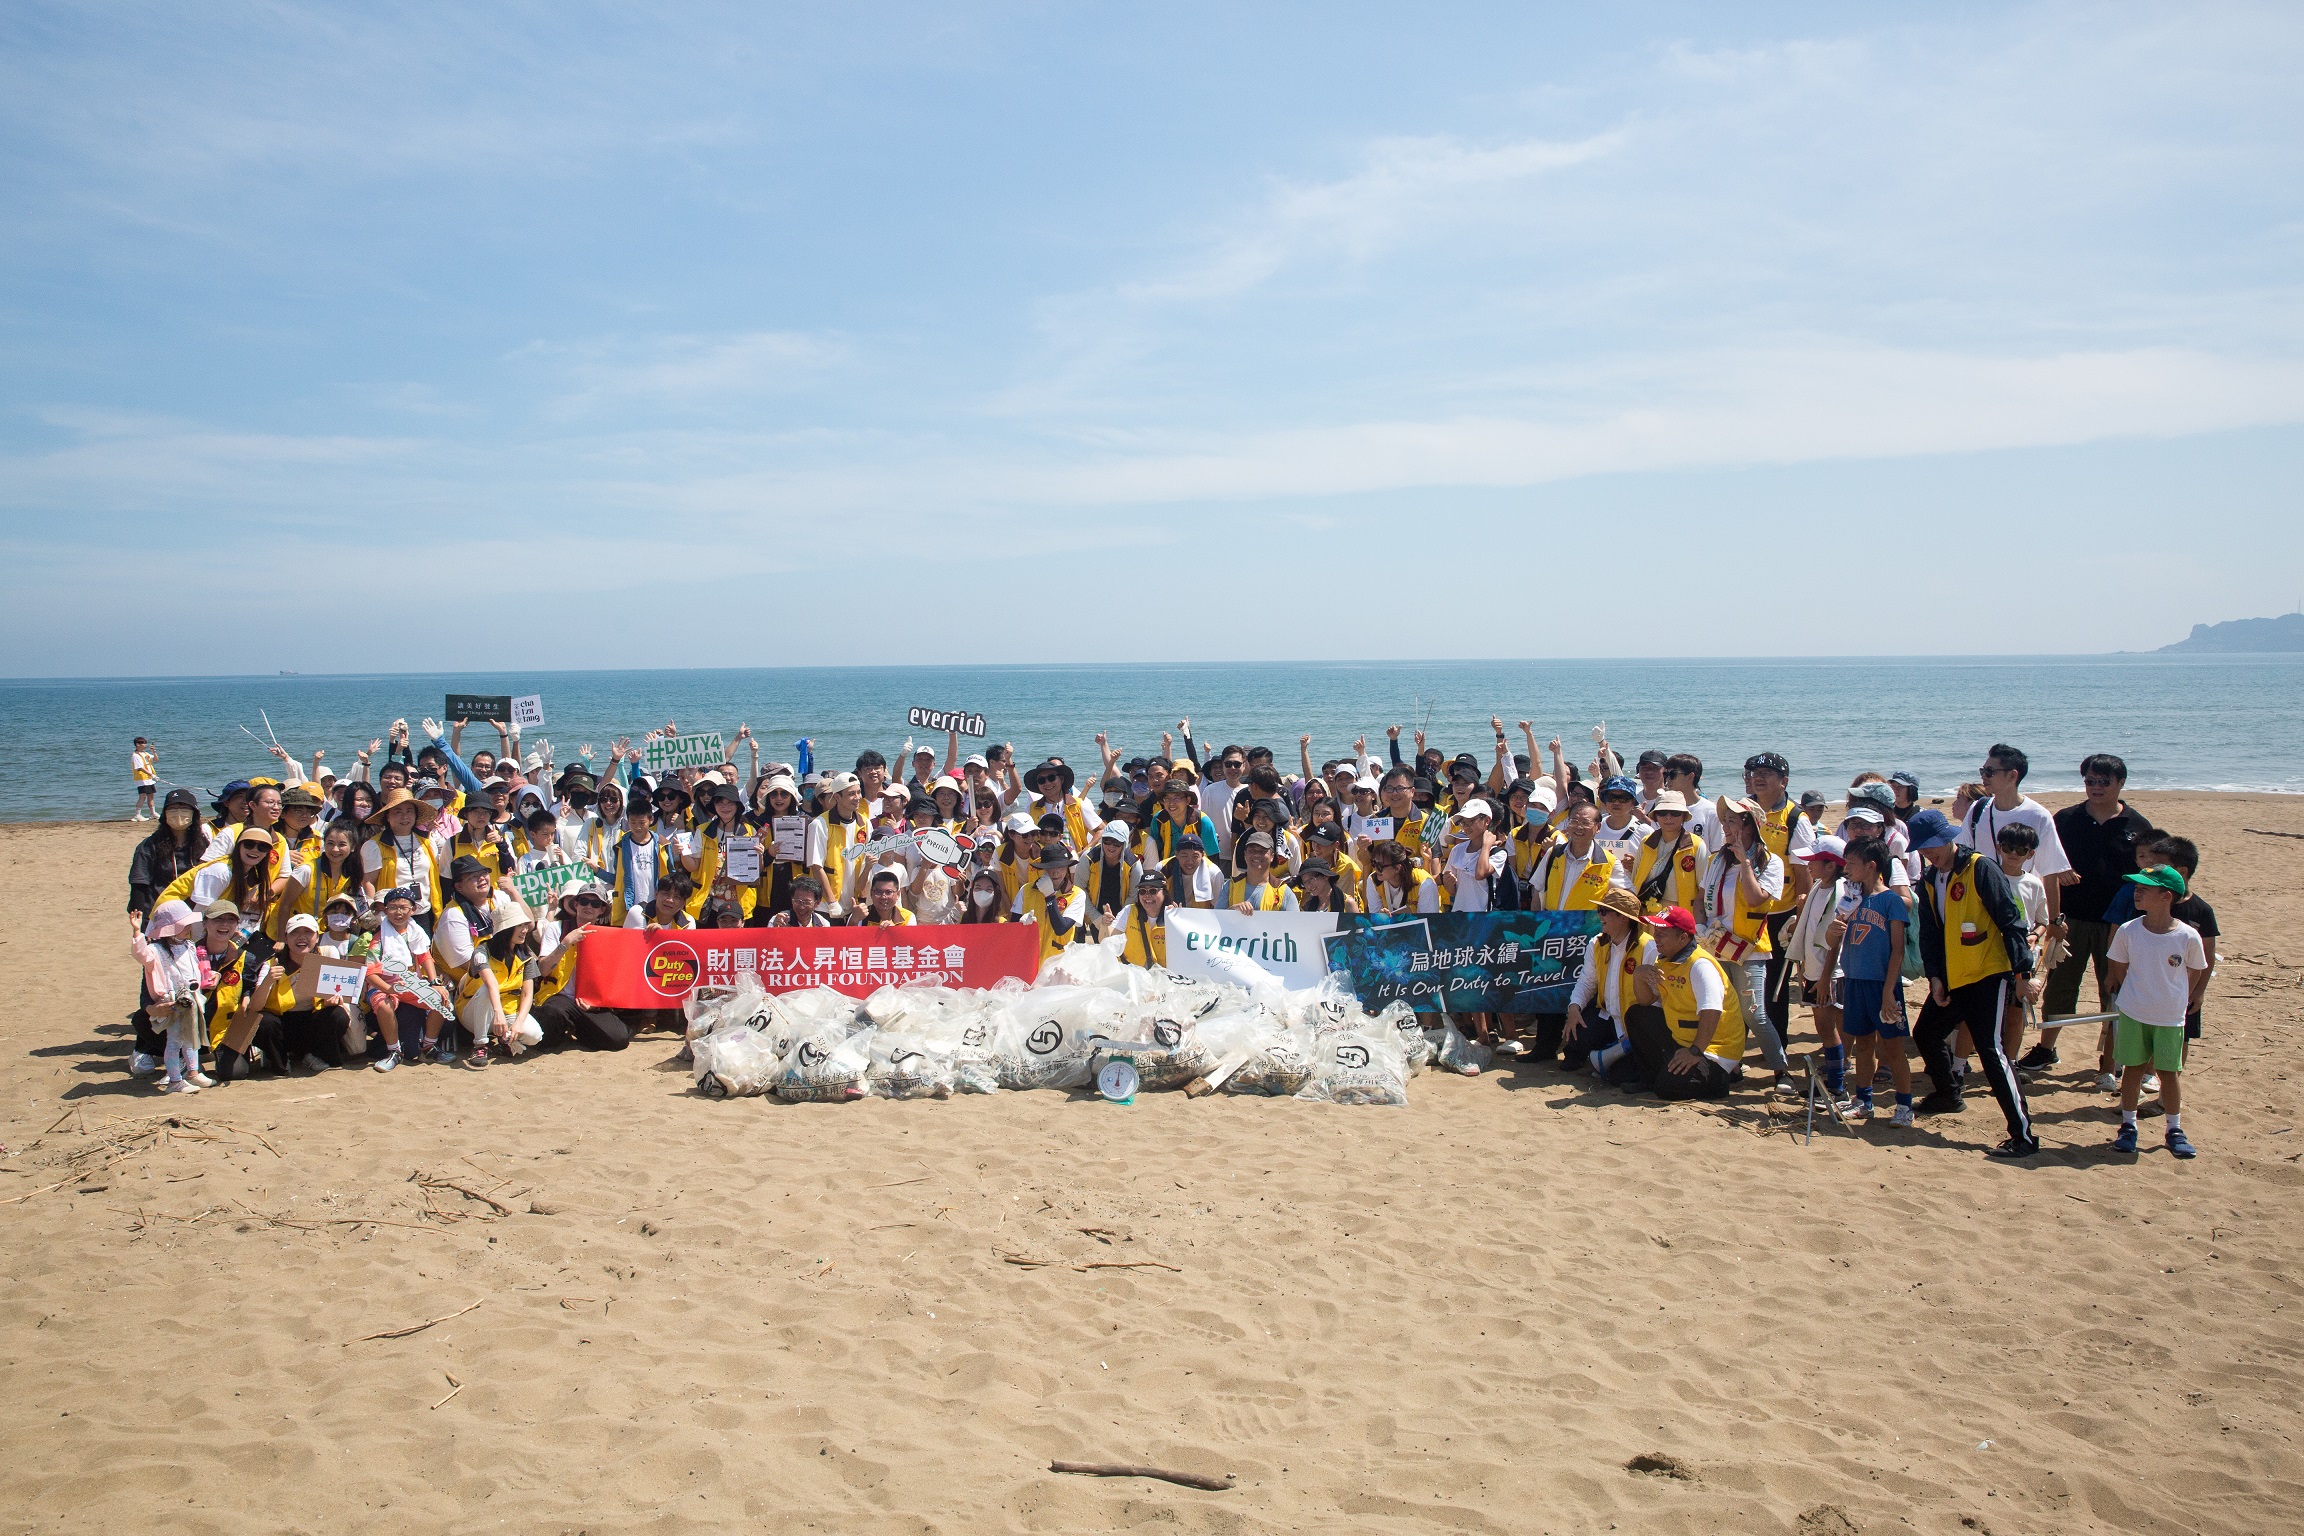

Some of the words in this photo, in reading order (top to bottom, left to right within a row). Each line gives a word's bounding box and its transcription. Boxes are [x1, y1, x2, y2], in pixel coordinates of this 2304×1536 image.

[520, 700, 534, 708] cha
[909, 708, 985, 736] everrich
[666, 751, 723, 768] TAIWAN
[1366, 819, 1389, 827] 第六組
[1420, 811, 1445, 844] ESG
[926, 838, 949, 855] everrich
[1598, 840, 1624, 849] 第八組
[1861, 907, 1887, 932] YORK
[1850, 923, 1872, 945] 17
[1186, 931, 1298, 962] everrich
[654, 956, 684, 971] Duty
[707, 944, 966, 972] 財團法人昇恆昌基金會
[322, 973, 358, 985] 第十七組
[661, 973, 693, 987] Free
[768, 973, 827, 986] RICH
[1377, 984, 1390, 998] It
[1395, 983, 1407, 997] Is
[1412, 981, 1444, 996] Our
[1450, 977, 1489, 996] Duty
[1494, 973, 1511, 987] to
[1517, 966, 1567, 985] Travel
